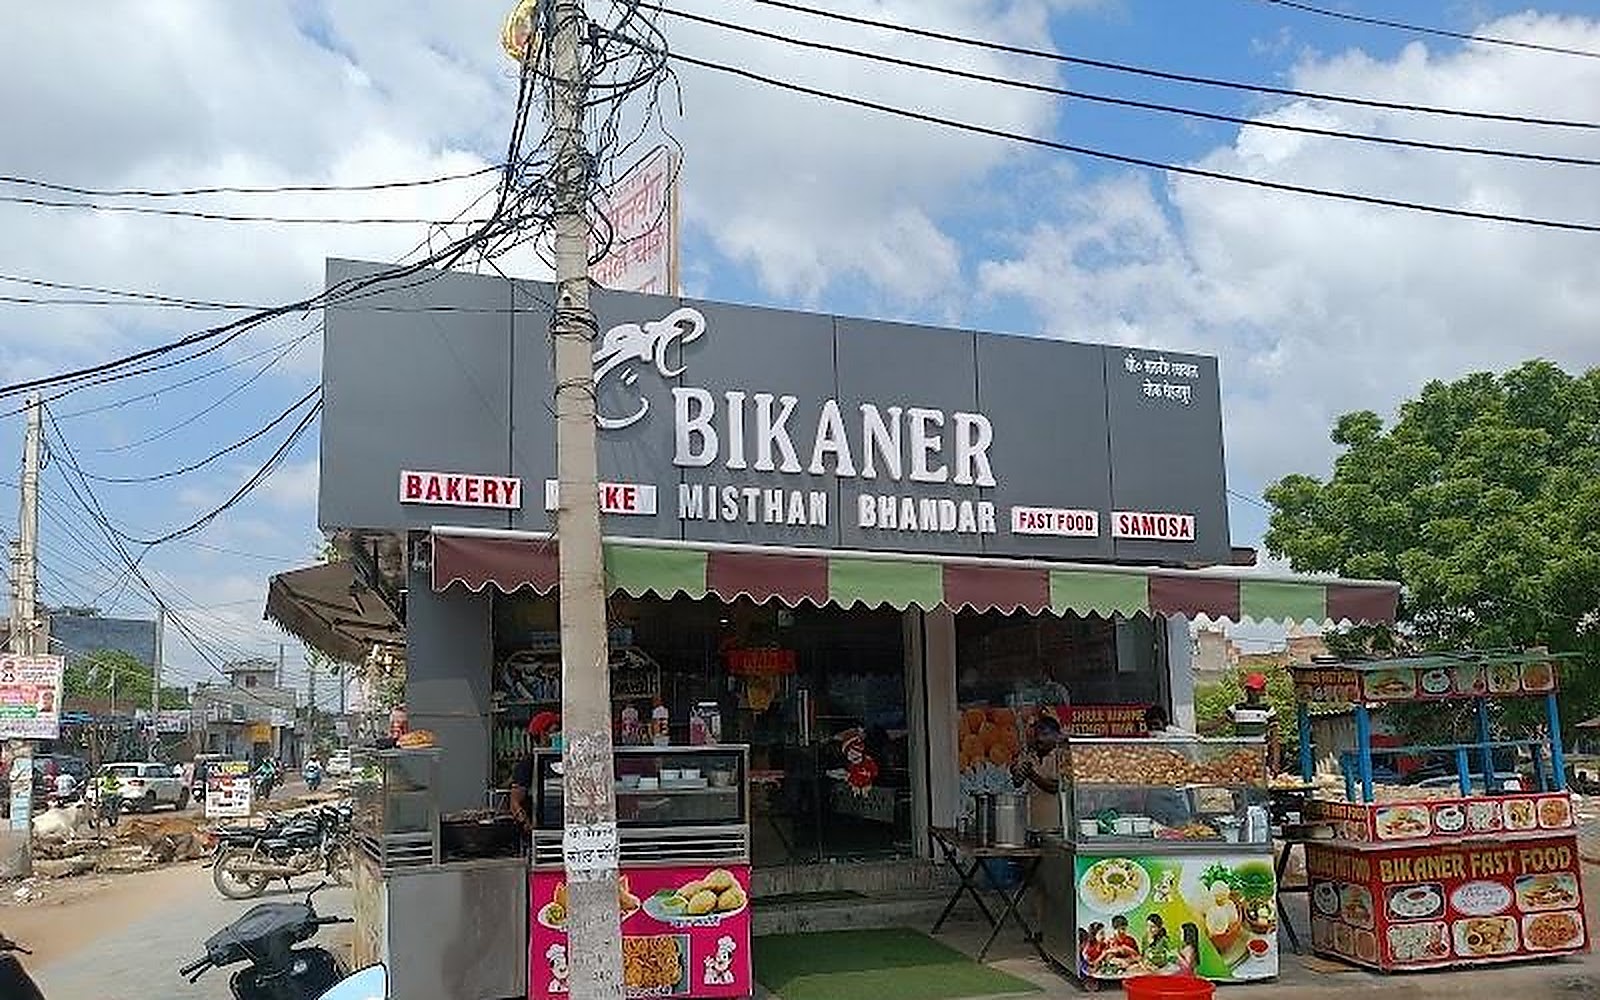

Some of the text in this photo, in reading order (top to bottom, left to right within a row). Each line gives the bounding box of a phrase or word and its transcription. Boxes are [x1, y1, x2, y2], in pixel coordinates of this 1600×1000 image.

[672, 387, 996, 487] BIKANER
[406, 474, 518, 506] BAKERY
[678, 484, 996, 534] MISTHAN BHANDAR
[1019, 511, 1095, 533] FAST FOOD
[1119, 516, 1192, 538] SAMOSA
[1380, 856, 1465, 883] BIKANER
[1475, 851, 1516, 879] FAST
[1521, 846, 1576, 870] FOOD
